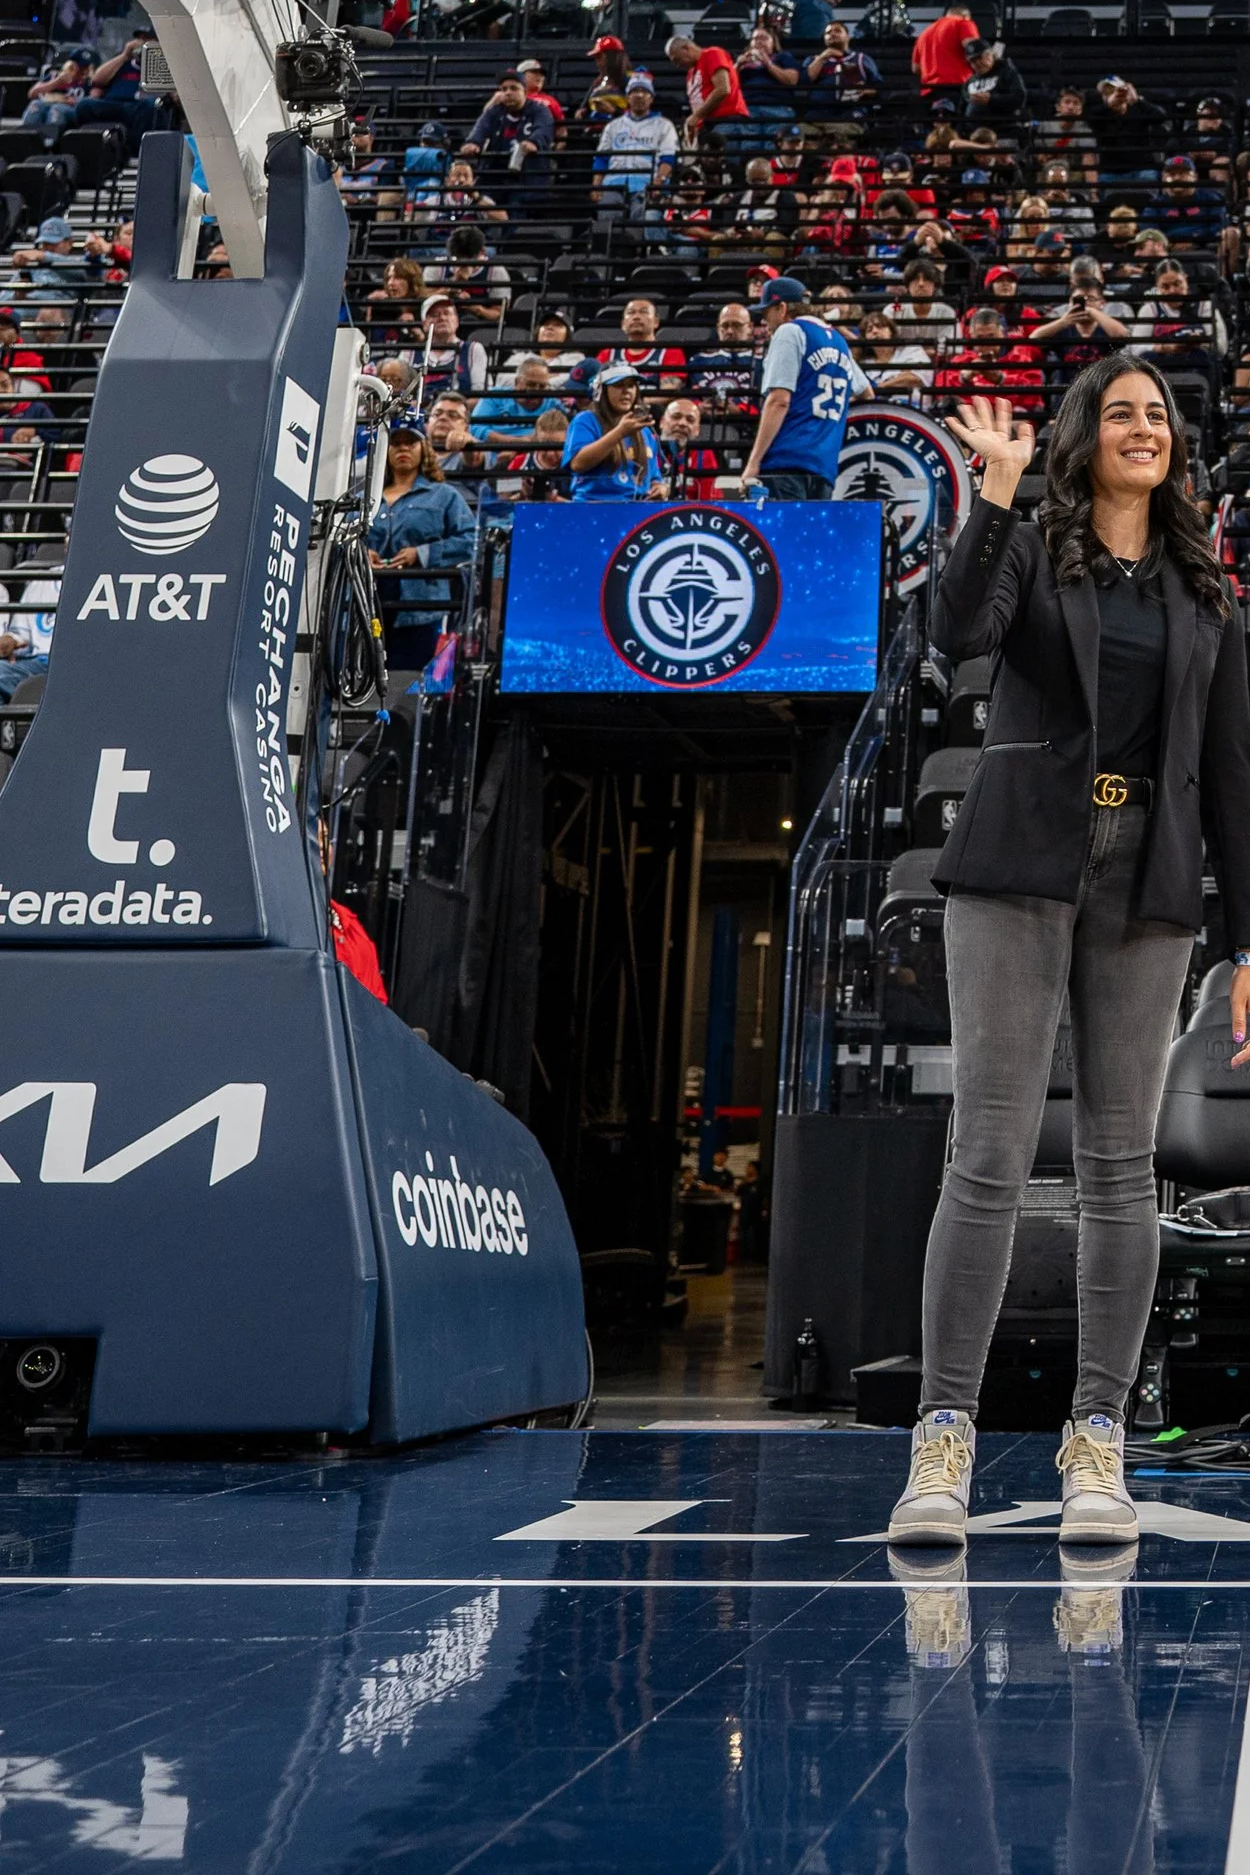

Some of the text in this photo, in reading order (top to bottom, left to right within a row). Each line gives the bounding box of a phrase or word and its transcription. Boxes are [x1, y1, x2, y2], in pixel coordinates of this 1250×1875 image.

[811, 373, 848, 422] 23
[615, 512, 771, 576] LOS ANGELES
[76, 573, 227, 622] AT&T
[255, 503, 287, 834] RESORT CASINO
[266, 512, 301, 835] PECHANGA
[622, 638, 752, 681] CLIPPERS
[392, 1149, 529, 1257] coinbase
